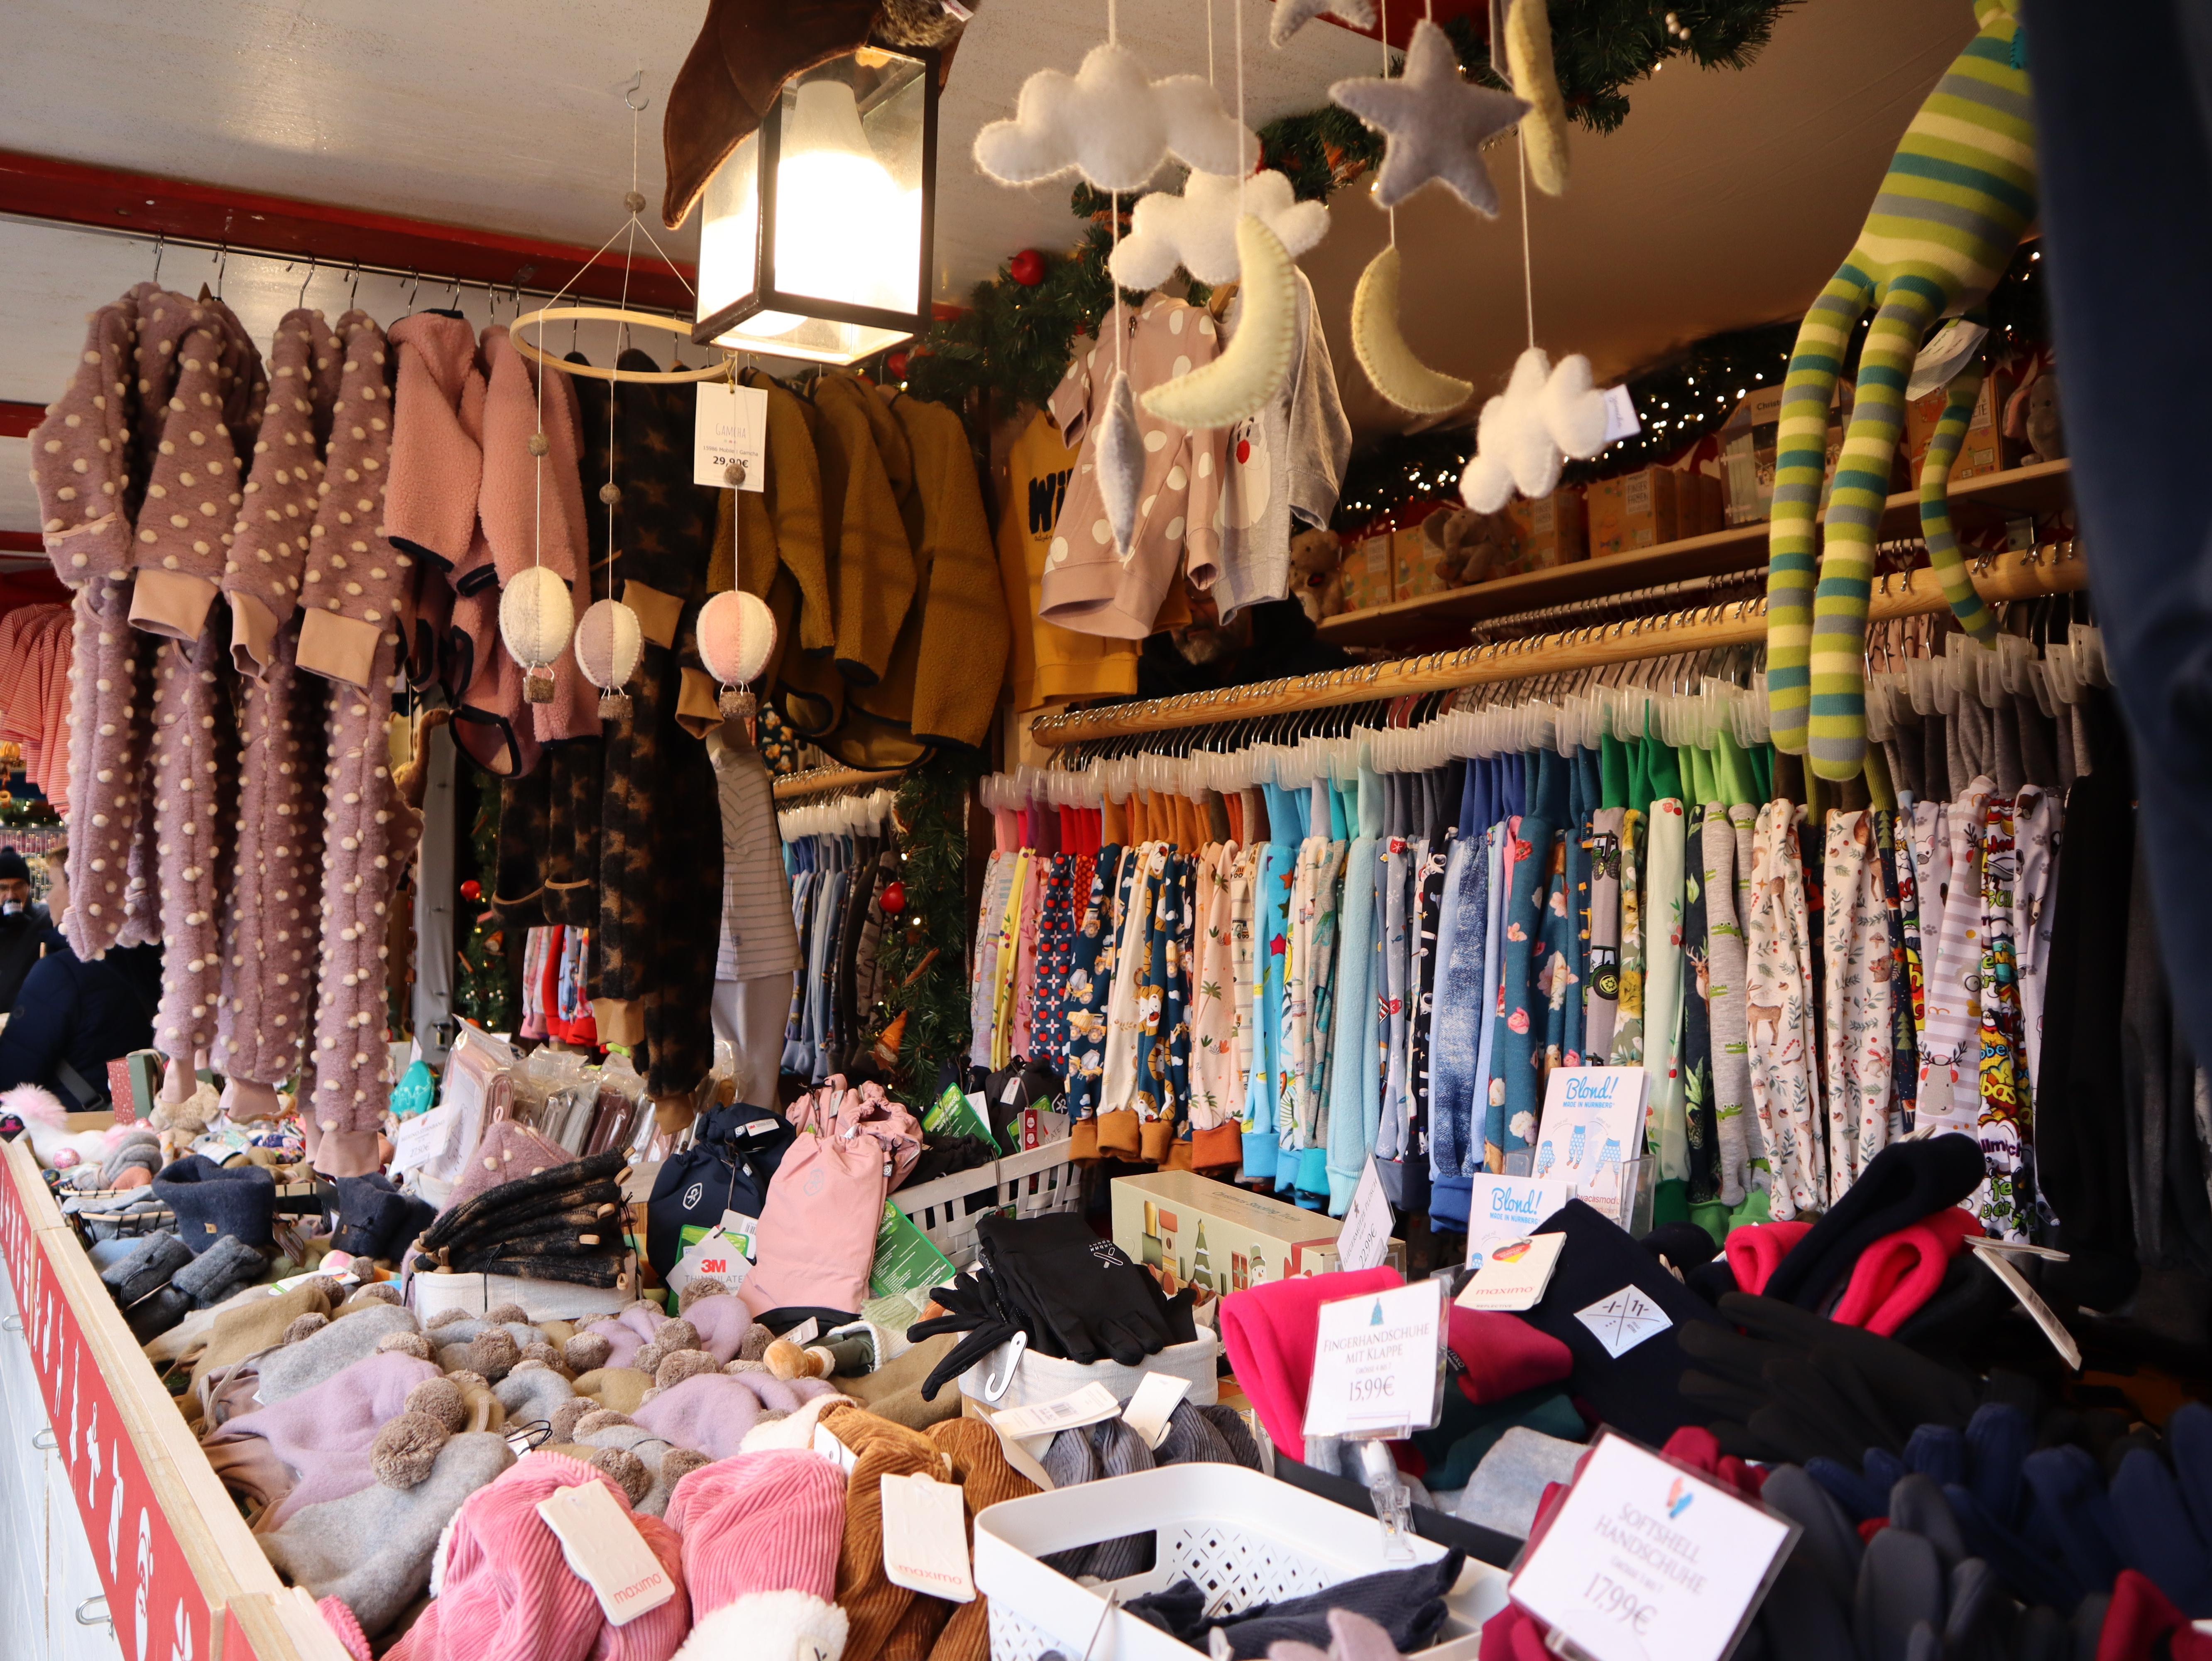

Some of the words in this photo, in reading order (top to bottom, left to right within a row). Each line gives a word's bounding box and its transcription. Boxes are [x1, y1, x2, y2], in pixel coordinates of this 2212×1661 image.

[715, 423, 746, 439] GAMCHA
[713, 456, 749, 468] 29,90€
[1566, 1075, 1619, 1100] Blond!
[1491, 1187, 1542, 1215] Blond!
[1490, 1212, 1503, 1220] MADE
[1090, 1243, 1113, 1252] URBAN
[1359, 1223, 1377, 1269] 22,99€
[701, 1259, 726, 1273] 3M
[1476, 1286, 1533, 1295] maximo
[1323, 1323, 1430, 1352] FINGERHANDSCHUHE
[1346, 1350, 1364, 1364] MIT
[1367, 1344, 1403, 1362] KLAPPE
[1349, 1375, 1395, 1402] 15,99€
[1617, 1502, 1701, 1565] SOFTSHELL
[1594, 1514, 1708, 1595] HANDSCHUHE
[898, 1564, 962, 1585] maximo
[613, 1573, 662, 1604] maximo
